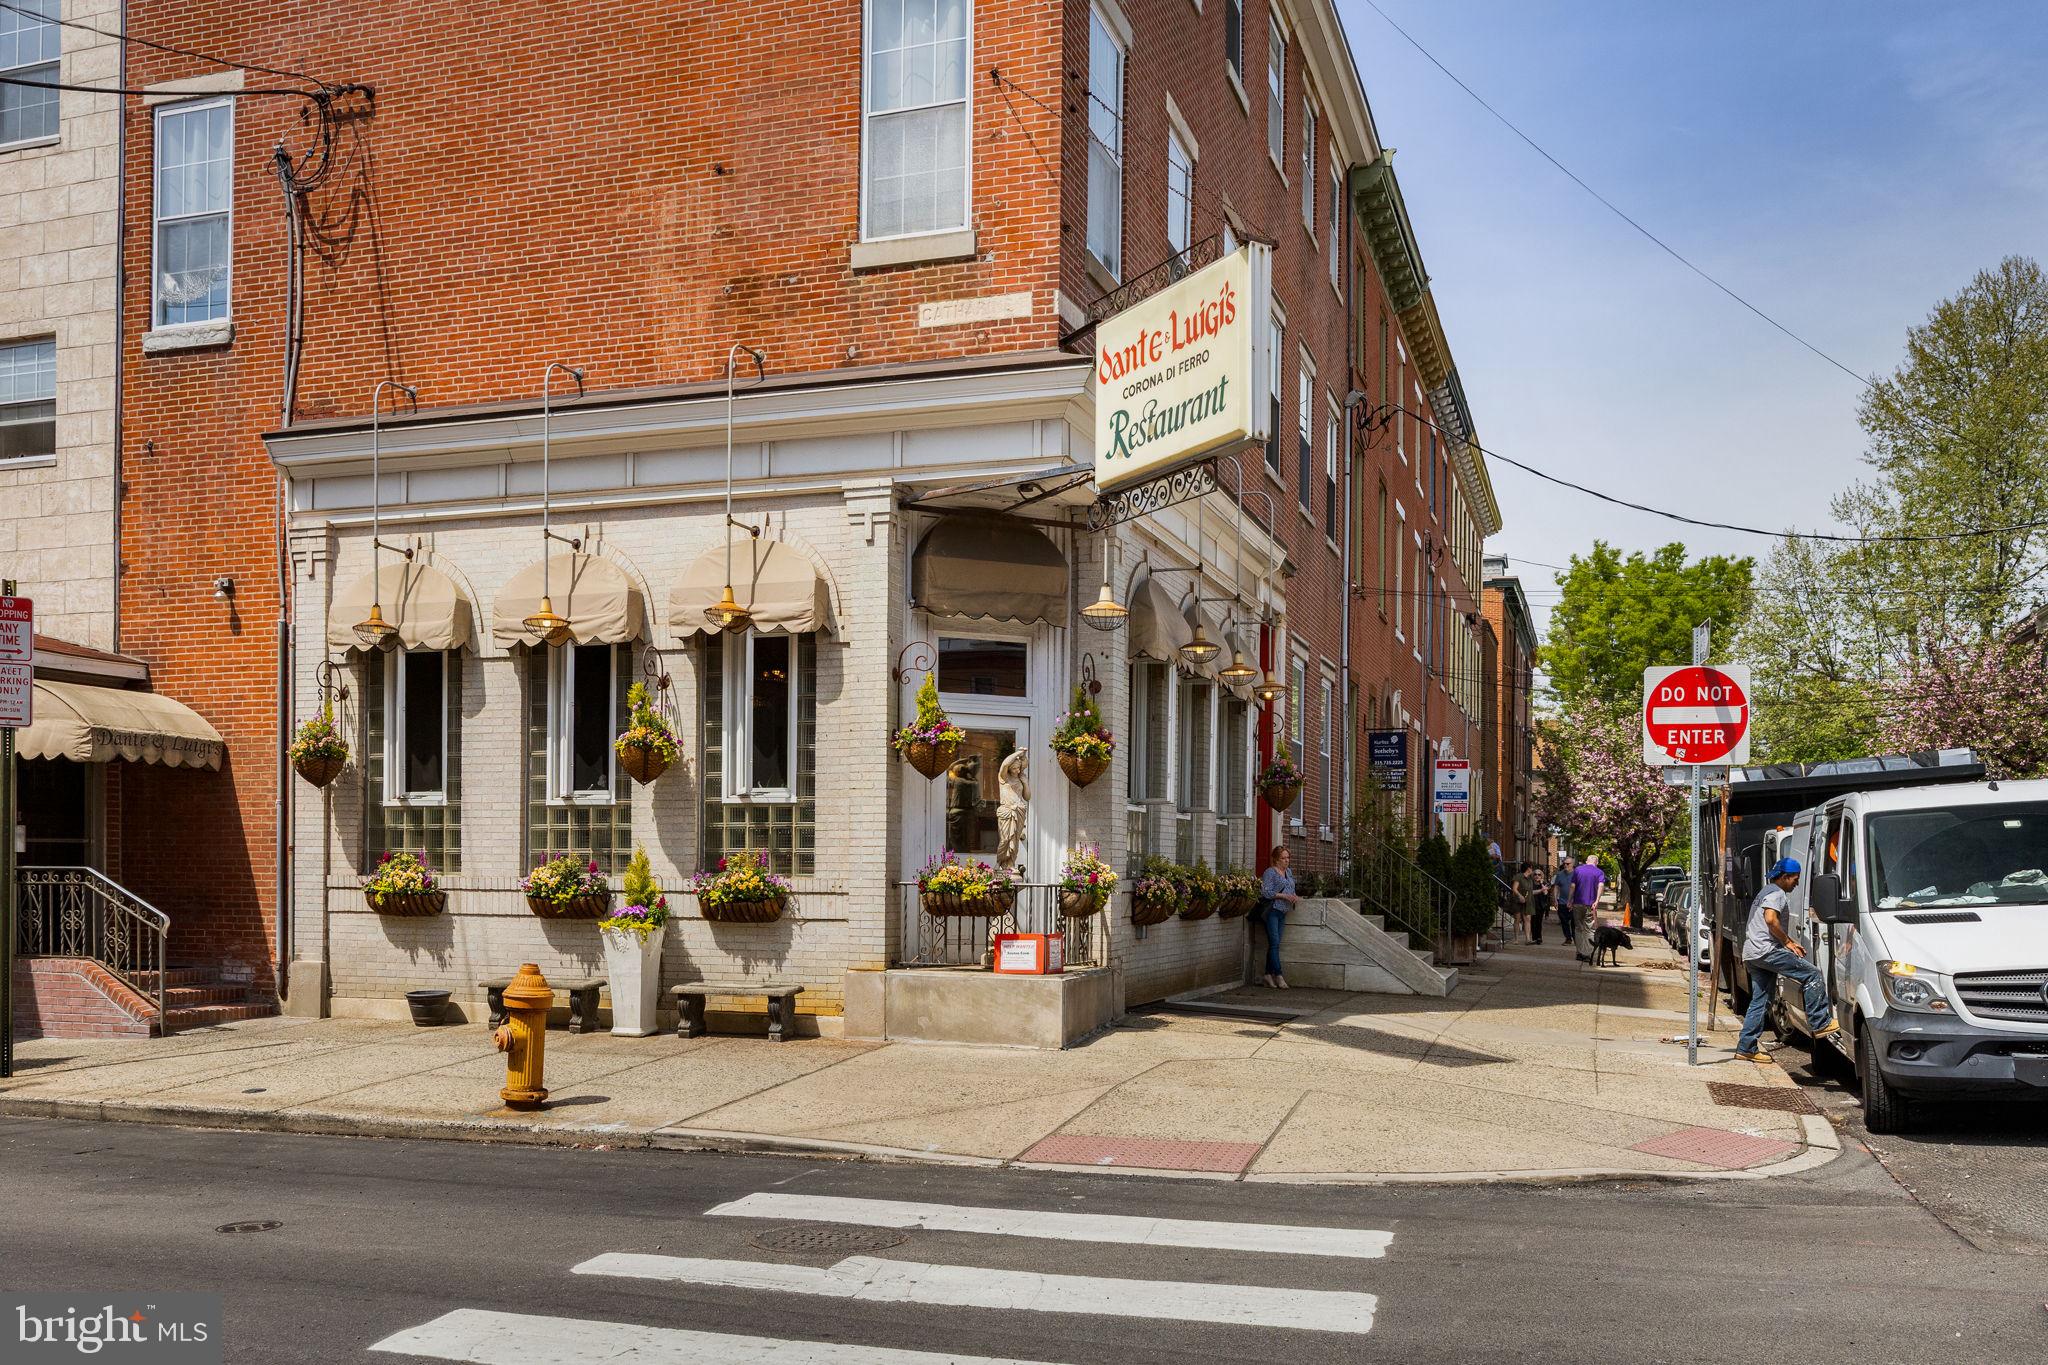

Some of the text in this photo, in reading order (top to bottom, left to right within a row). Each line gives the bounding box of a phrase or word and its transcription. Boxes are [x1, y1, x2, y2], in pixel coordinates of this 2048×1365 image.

[1164, 332, 1171, 344] &
[1122, 350, 1210, 400] CORONA DI FERRO
[1105, 374, 1230, 460] Restaurant
[2, 599, 14, 608] NO
[1661, 686, 1733, 702] DO NOT
[97, 729, 220, 758] Dante & Luigi's
[1668, 729, 1725, 745] ENTER
